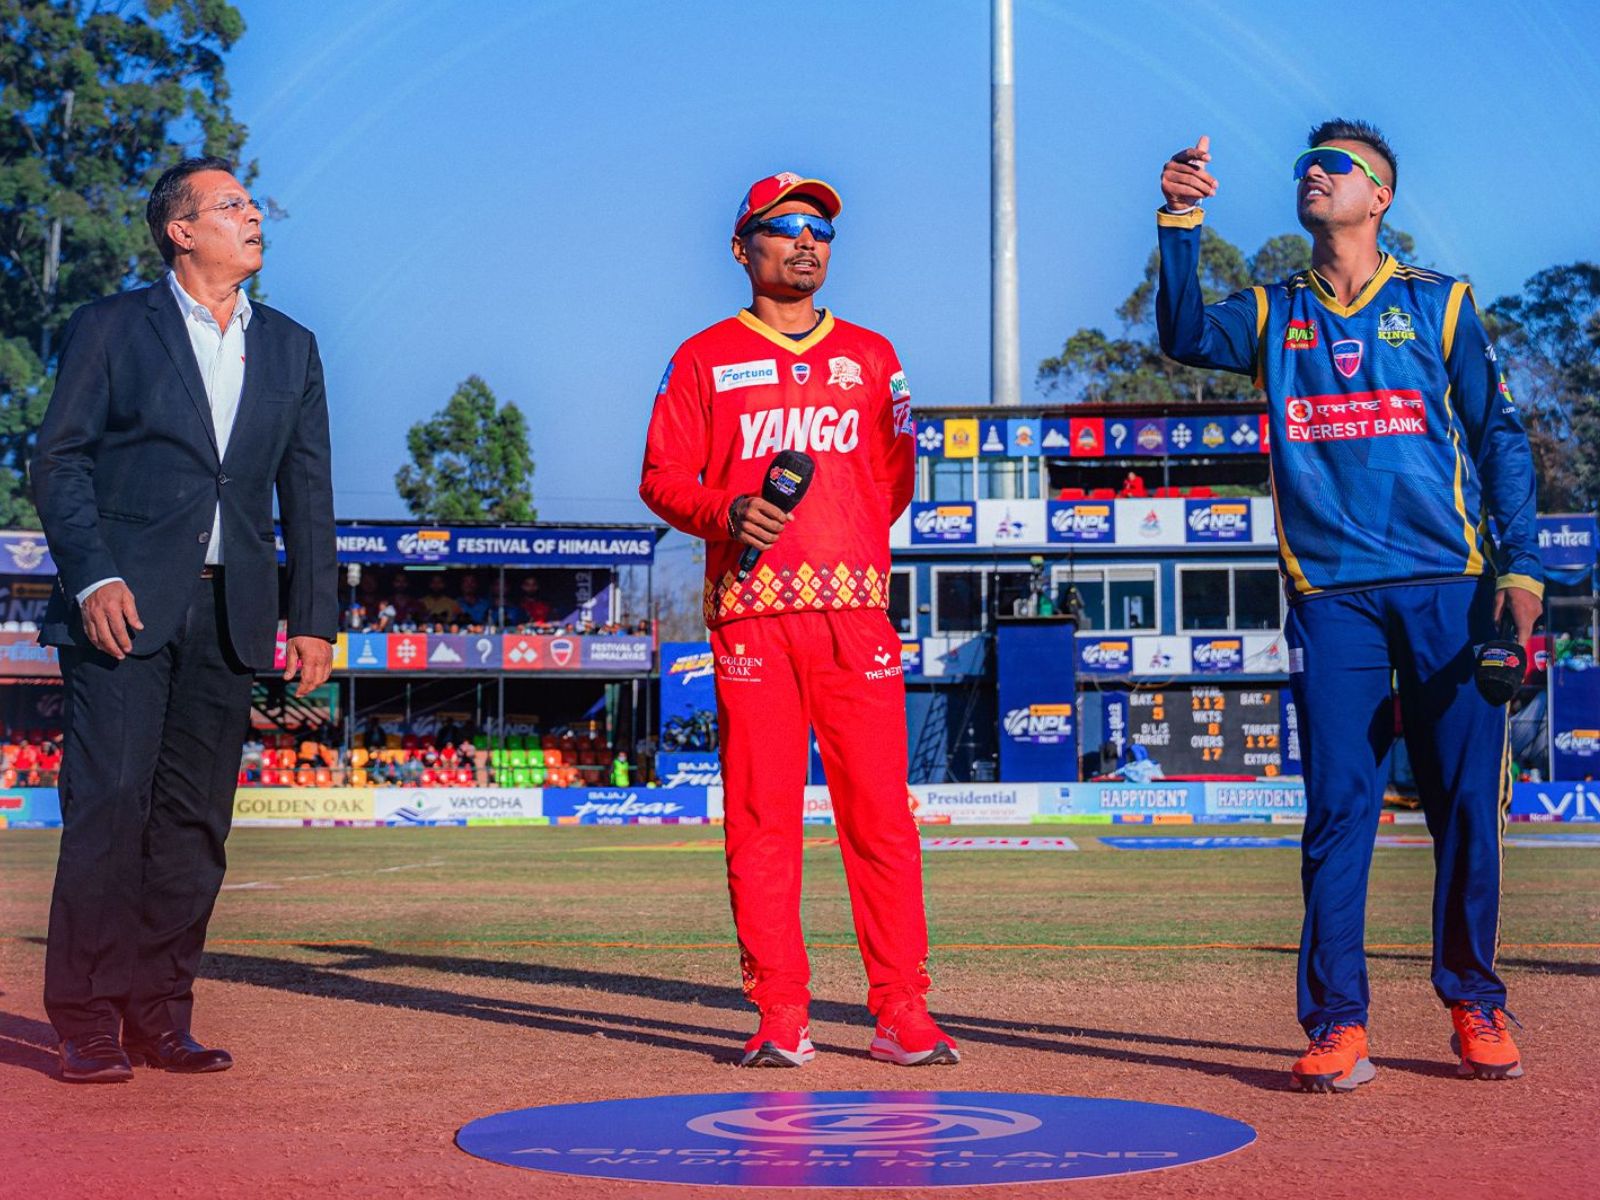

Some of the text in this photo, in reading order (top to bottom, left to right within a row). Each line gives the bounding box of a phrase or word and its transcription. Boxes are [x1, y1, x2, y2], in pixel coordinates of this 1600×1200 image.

[1378, 331, 1415, 340] KINGS
[721, 368, 773, 383] Fortuna
[740, 406, 859, 460] YANGO
[1288, 418, 1424, 440] EVEREST BANK
[935, 516, 973, 531] NPL
[1074, 515, 1109, 530] NPL
[1209, 514, 1247, 530] NPL
[336, 537, 649, 555] NEPAL NPL FESTIVAL OF HIMALAYAS
[591, 643, 646, 652] FESTIVAL OF
[591, 652, 646, 660] HIMALAYAS
[1100, 649, 1129, 662] NPL
[1210, 648, 1240, 661] NPL
[719, 656, 762, 667] GOLDEN
[727, 665, 751, 676] OAK
[865, 669, 884, 680] THE
[1192, 696, 1225, 710] 112
[1192, 710, 1223, 723] WKTS
[1028, 716, 1071, 735] NPL
[1241, 724, 1280, 736] TARGET
[1132, 733, 1171, 746] TARGET
[1190, 735, 1224, 748] OVERS
[1246, 735, 1278, 748] 112
[1202, 748, 1223, 760] 17
[1244, 753, 1281, 766] EXTRAS
[449, 797, 522, 809] VAYODHA
[927, 790, 1017, 805] Presidential
[1100, 789, 1188, 808] HAPPYDENT
[1218, 789, 1305, 808] HAPPYDENT
[237, 799, 364, 813] GOLDEN OAK
[511, 1147, 1179, 1159] ASHOK LEYLAND
[589, 1157, 1082, 1168] No Dream Too Far
